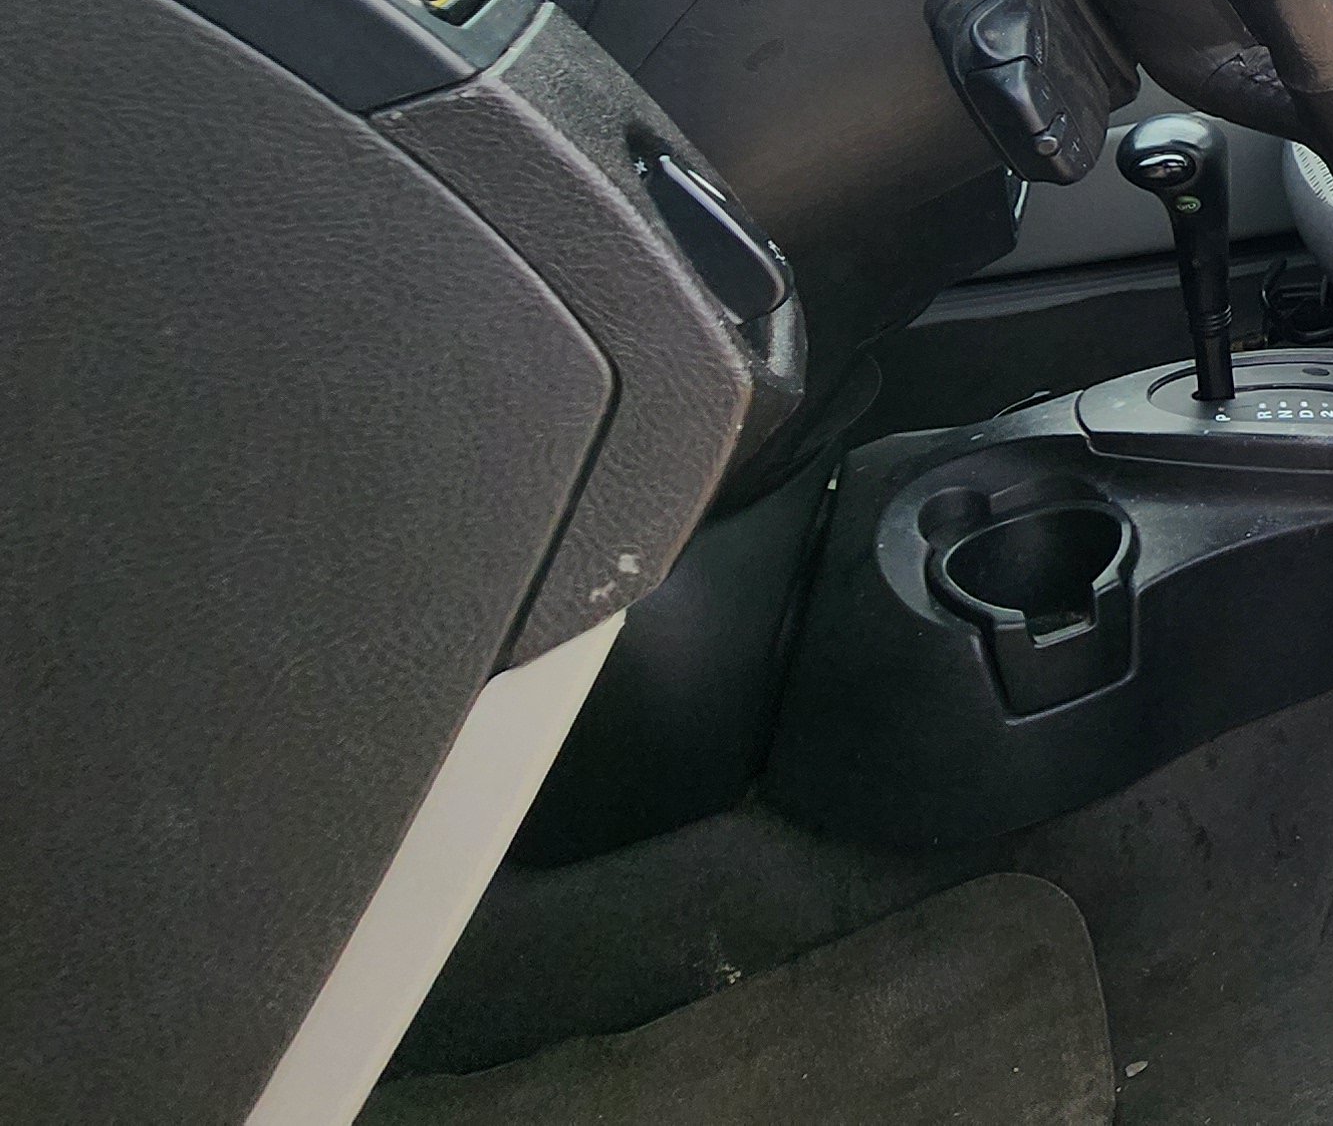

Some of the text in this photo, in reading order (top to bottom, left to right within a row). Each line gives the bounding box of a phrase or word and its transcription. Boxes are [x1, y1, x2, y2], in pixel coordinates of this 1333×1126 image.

[1216, 414, 1231, 422] P
[1257, 410, 1272, 420] R
[1278, 410, 1293, 419] N
[1300, 410, 1314, 419] D
